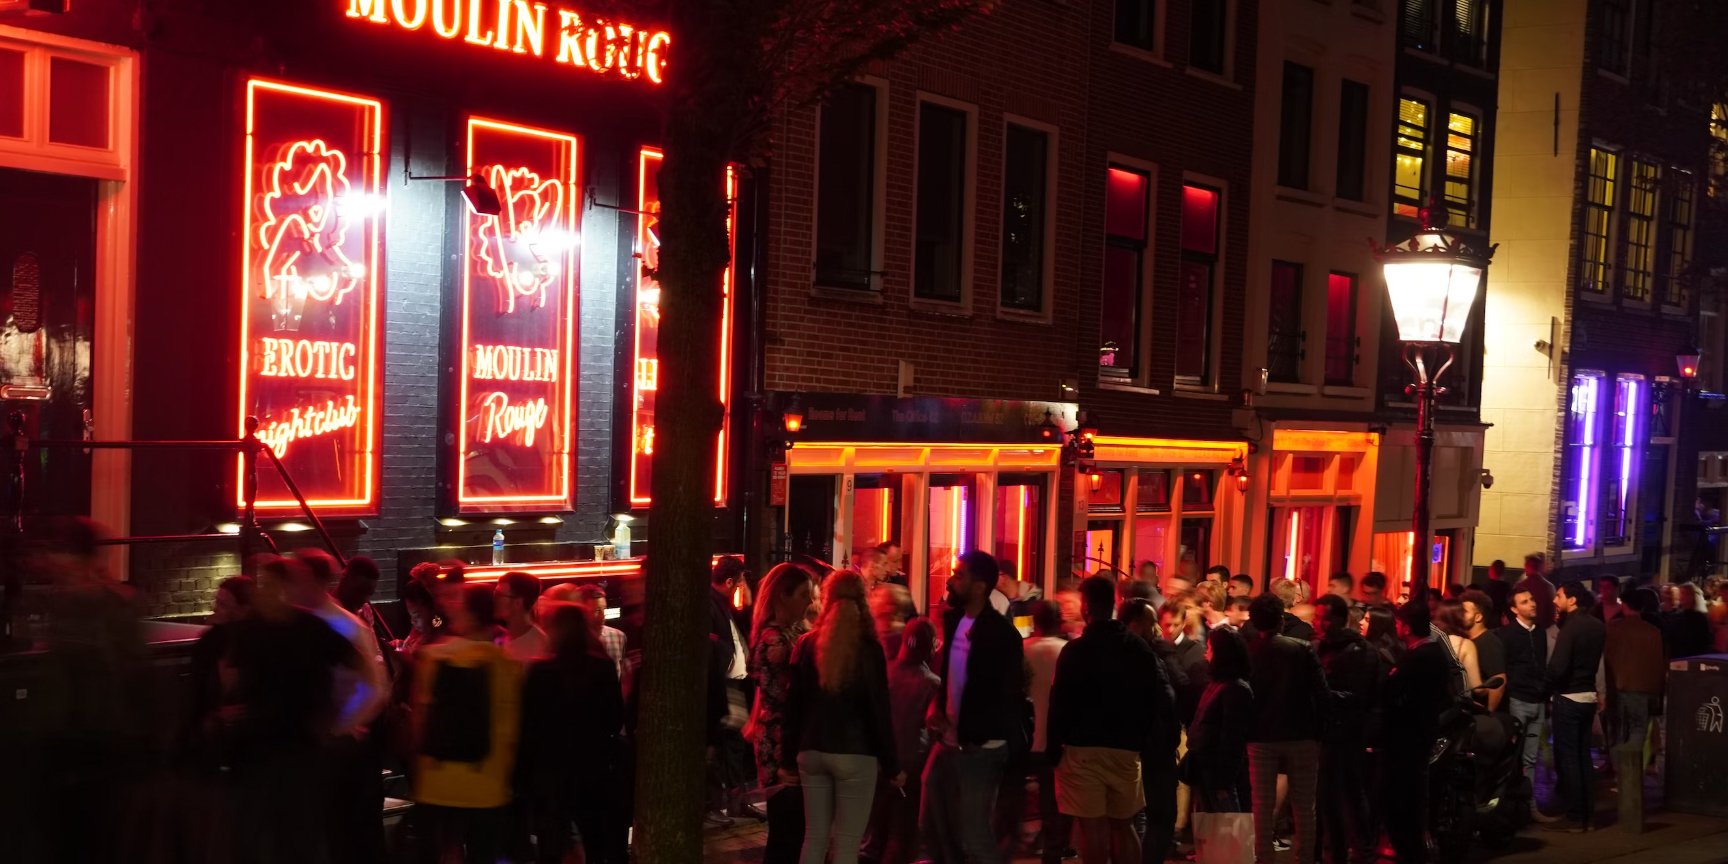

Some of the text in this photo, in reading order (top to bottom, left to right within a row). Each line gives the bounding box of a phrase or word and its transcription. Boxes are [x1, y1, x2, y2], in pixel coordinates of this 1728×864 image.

[345, 0, 548, 57] MOULIN
[260, 337, 356, 381] EROTIC
[473, 344, 559, 382] MOULIN
[483, 391, 548, 448] Rouge
[846, 479, 852, 492] 9
